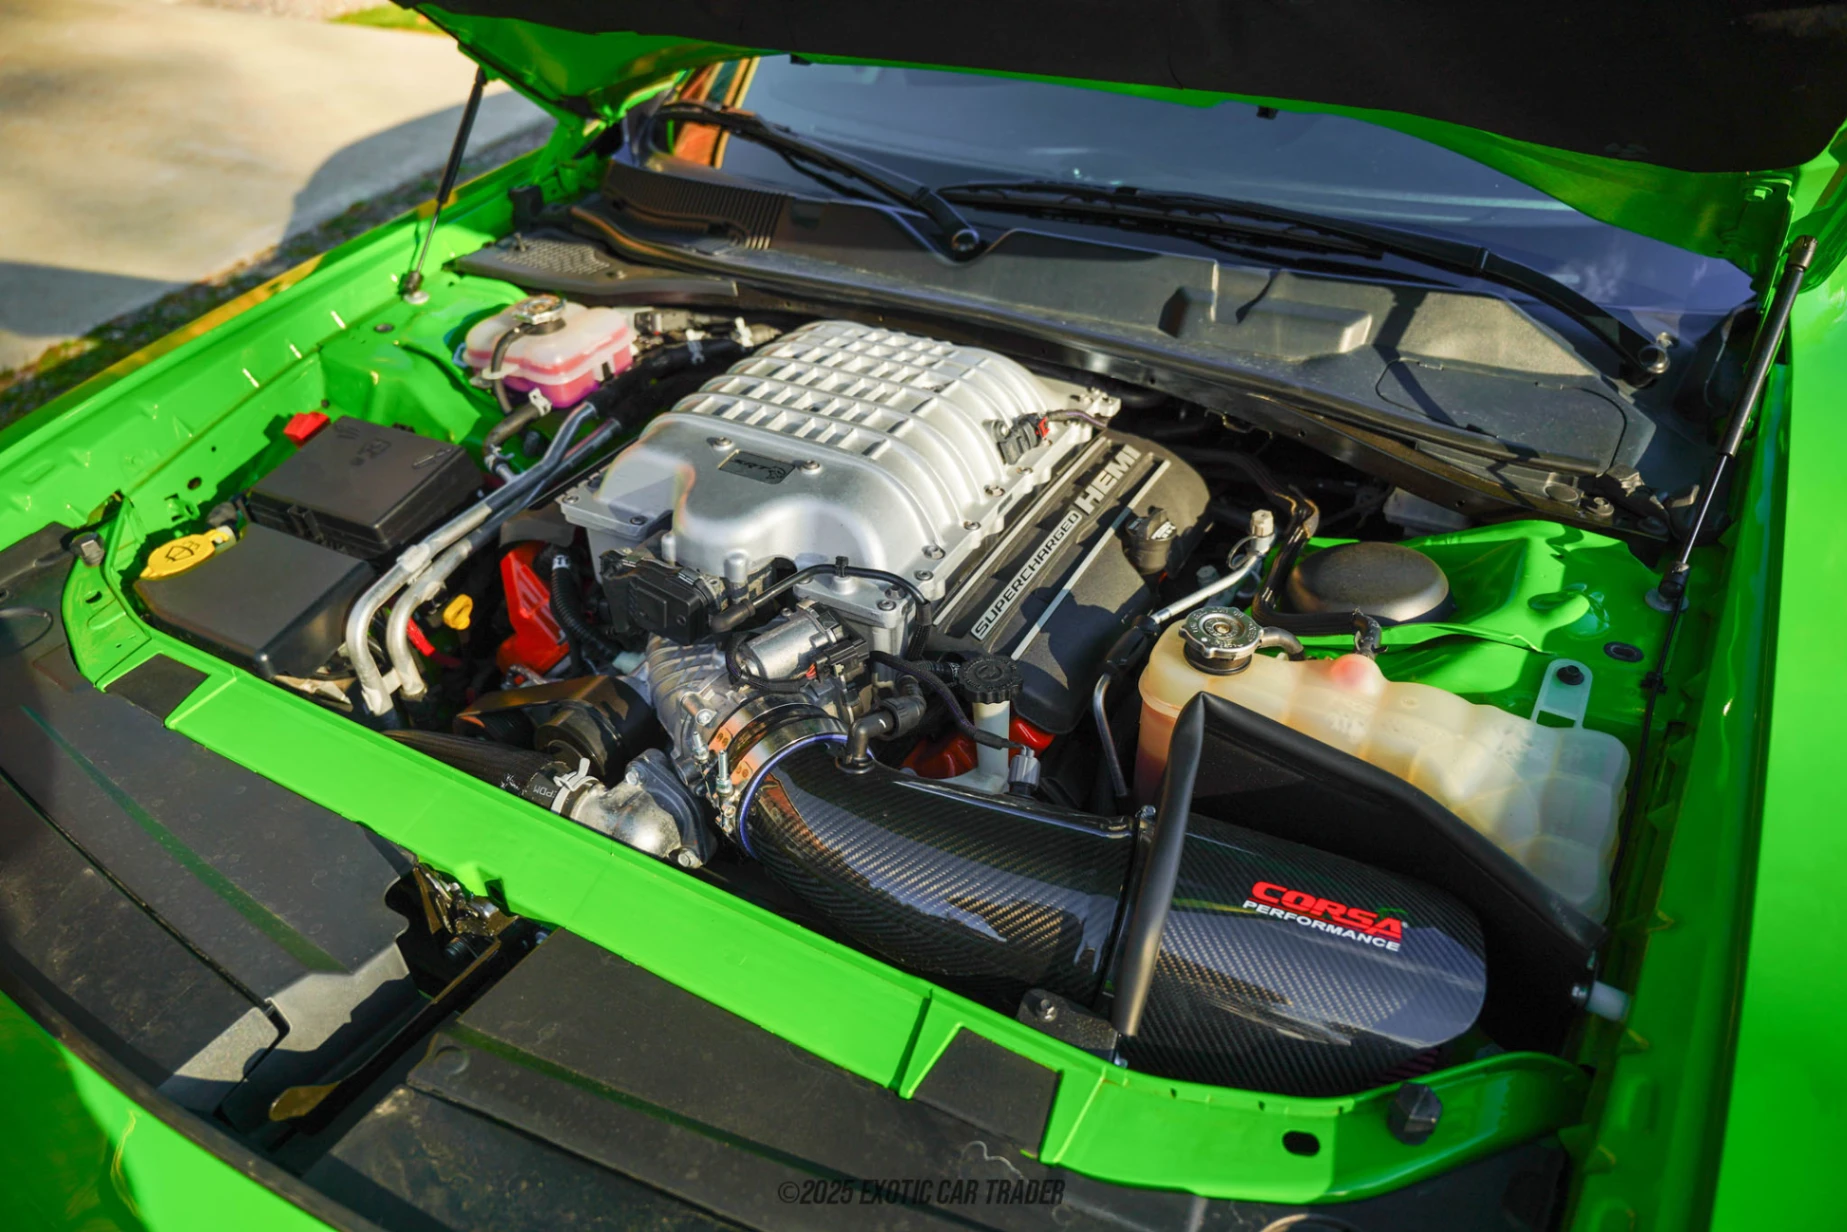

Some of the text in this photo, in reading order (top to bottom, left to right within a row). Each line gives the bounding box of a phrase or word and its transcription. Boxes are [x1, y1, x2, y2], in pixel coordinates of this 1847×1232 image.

[1075, 444, 1141, 515] HEMI
[975, 512, 1080, 637] SUPERCHARGED
[1242, 899, 1401, 952] PERFORMANCE
[1251, 880, 1402, 939] CORSA
